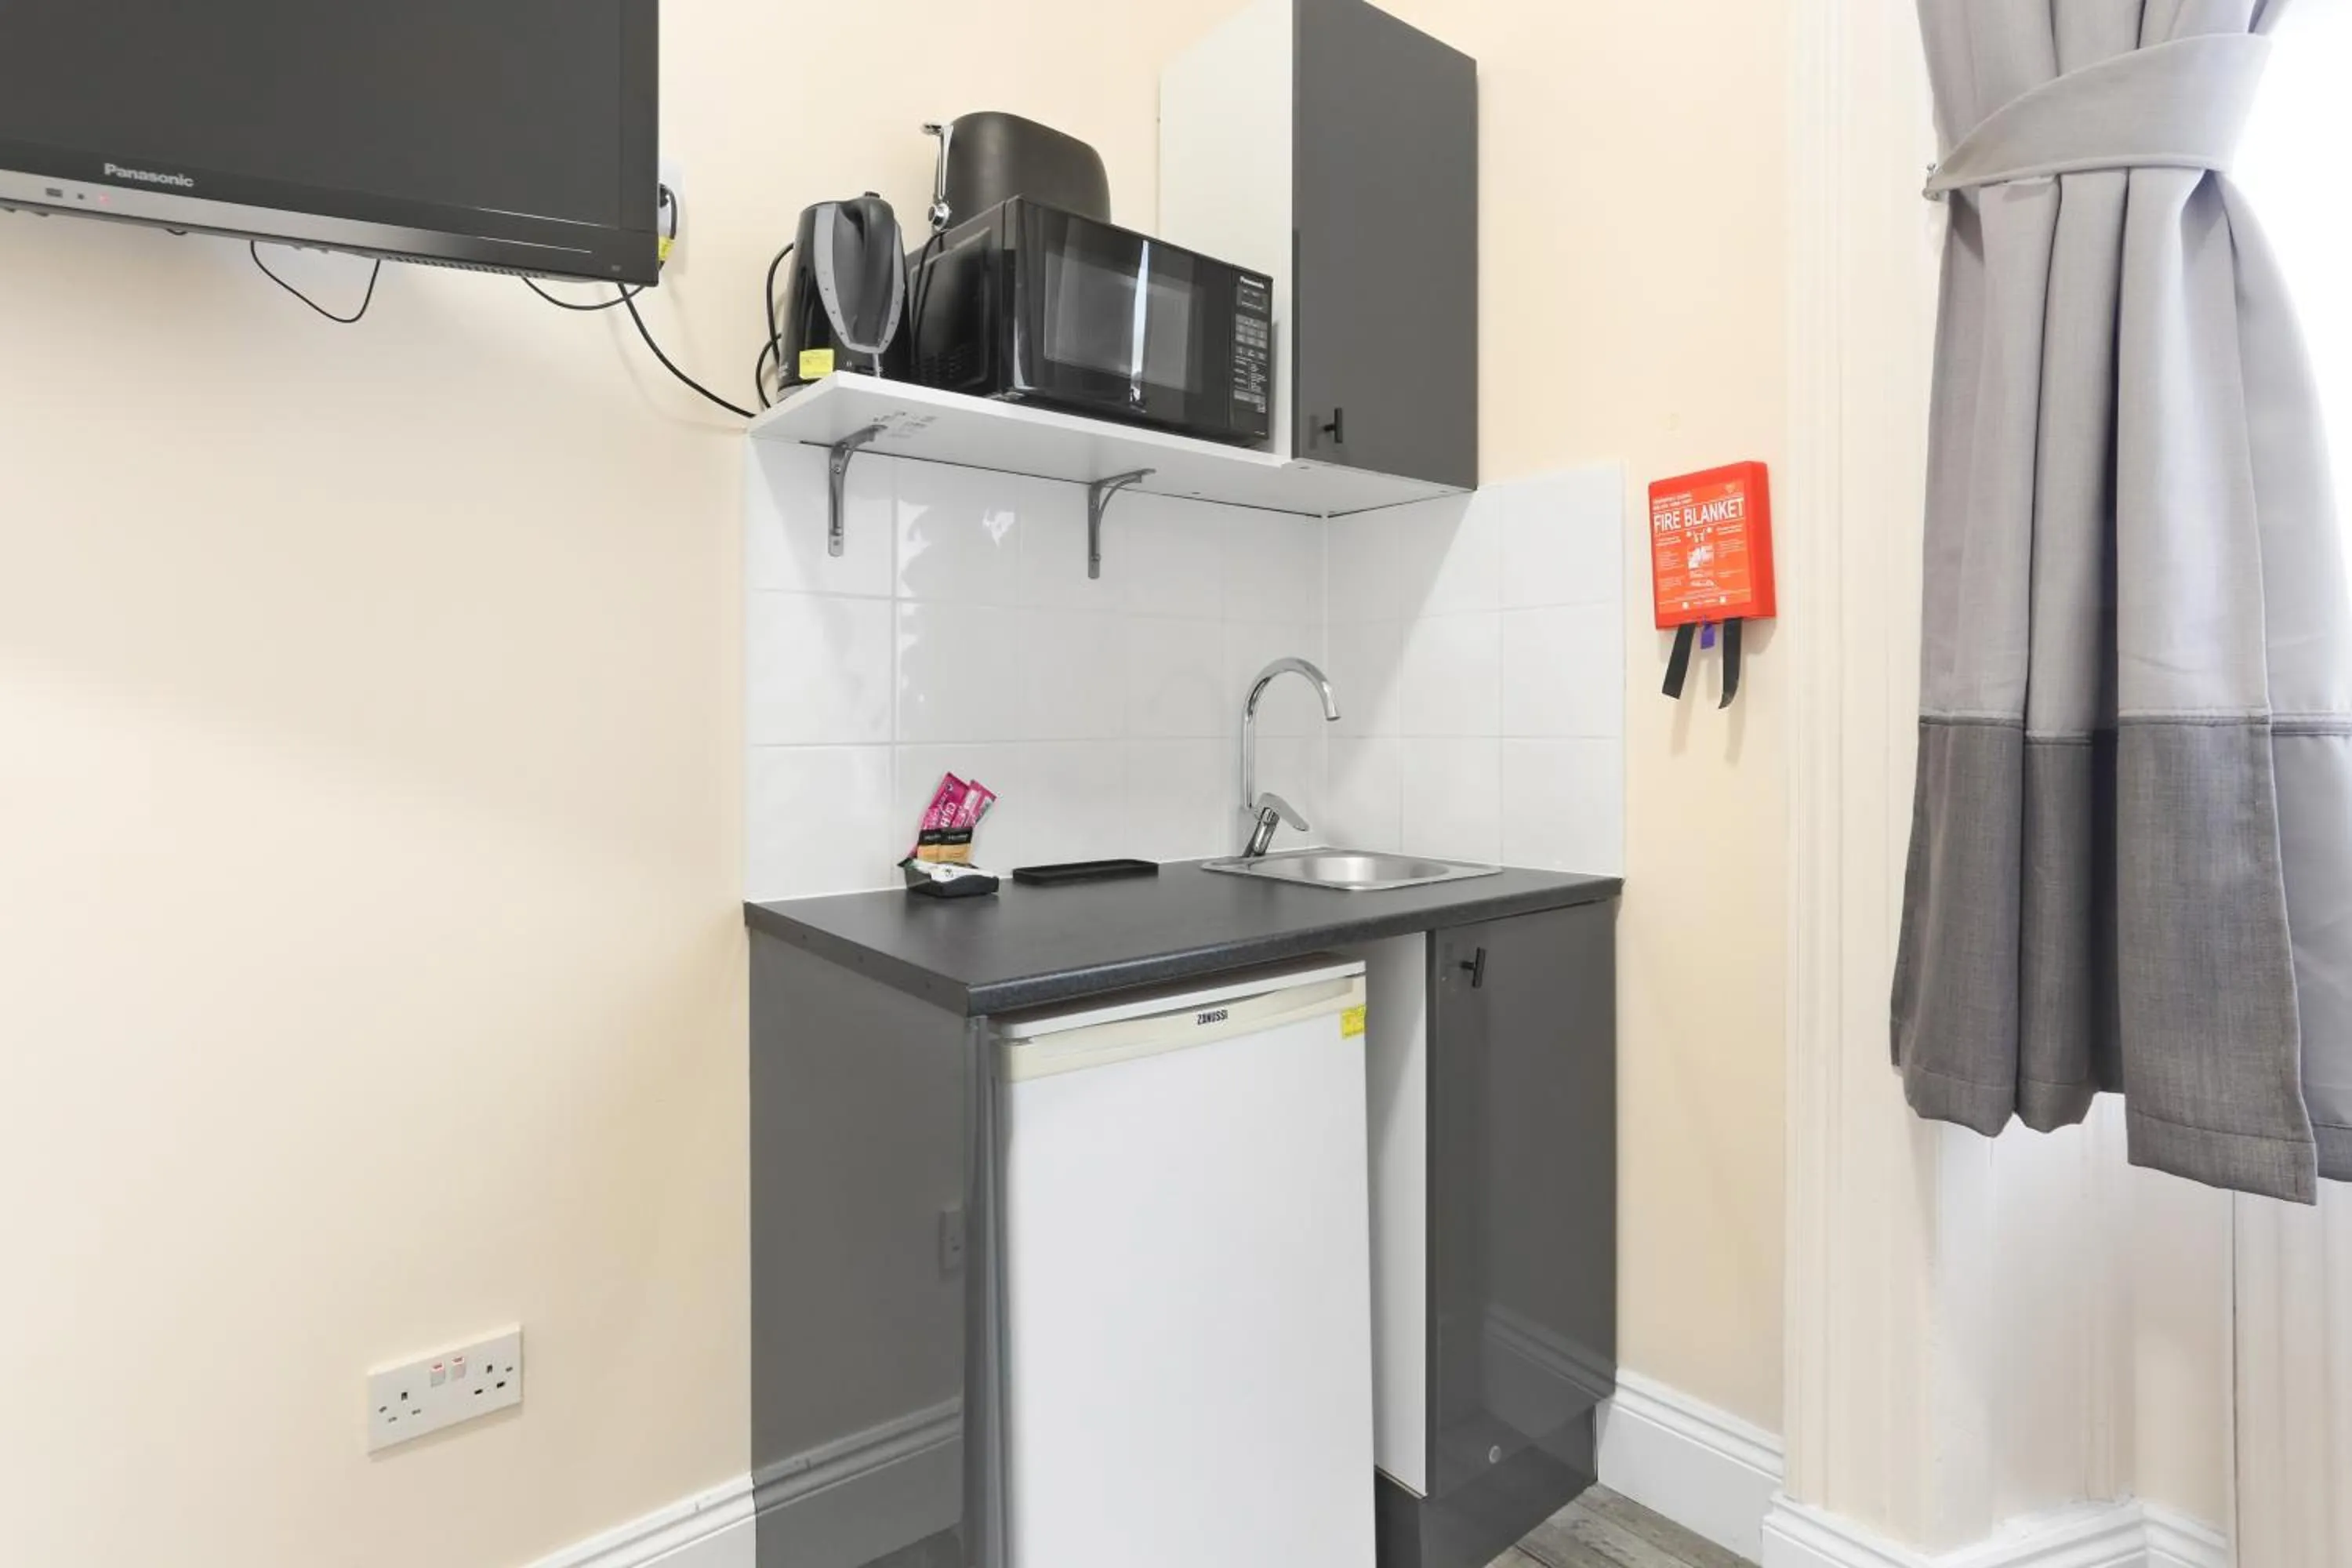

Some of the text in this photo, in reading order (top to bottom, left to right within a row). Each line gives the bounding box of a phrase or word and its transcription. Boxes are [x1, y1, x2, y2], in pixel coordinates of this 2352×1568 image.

[103, 162, 194, 187] Panasonic
[1653, 510, 1682, 534] FIRE
[1684, 497, 1744, 528] BLANKET
